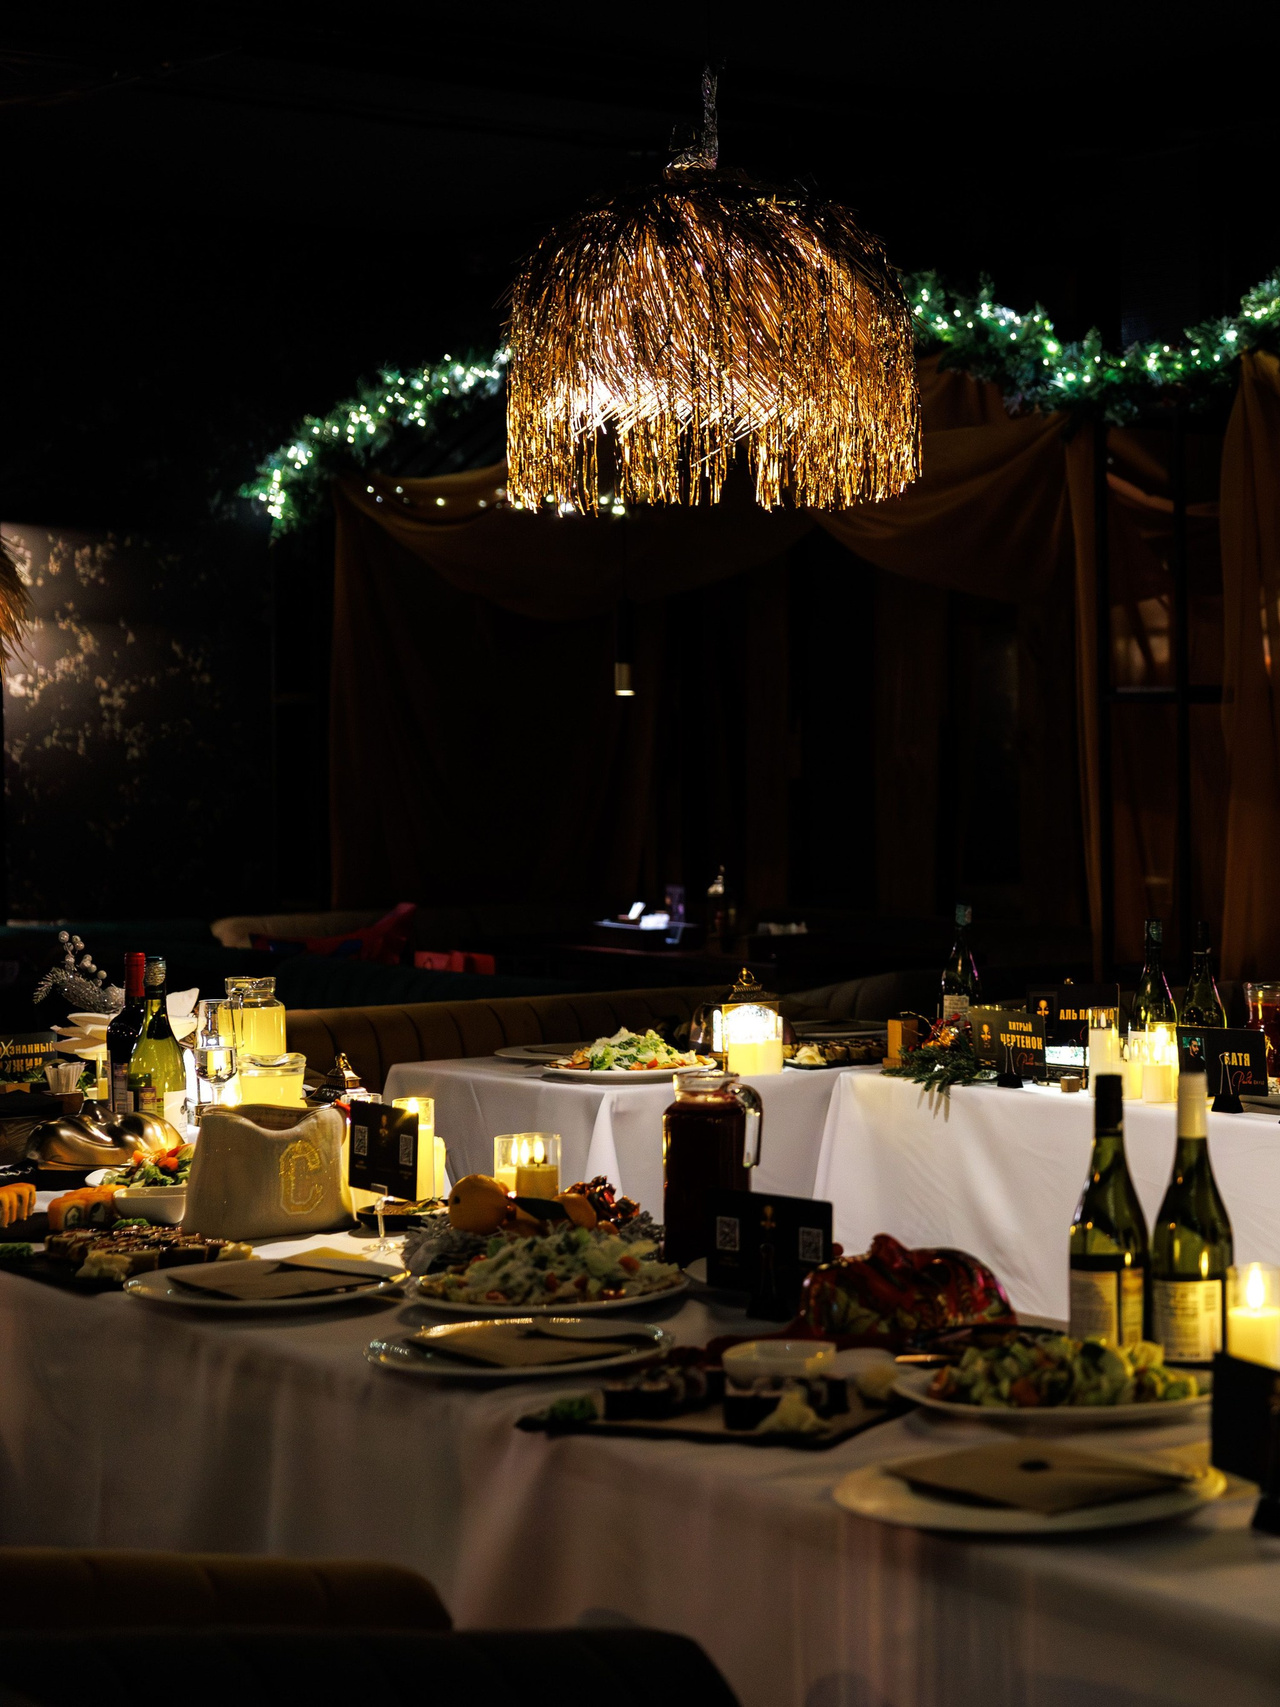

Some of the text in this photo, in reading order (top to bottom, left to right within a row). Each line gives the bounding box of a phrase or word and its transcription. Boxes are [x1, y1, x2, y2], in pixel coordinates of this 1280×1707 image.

[1059, 1008, 1078, 1021] АЛЬ
[0, 1041, 56, 1056] ЗНАННЫЙ
[1223, 1051, 1251, 1067] БАТЯ
